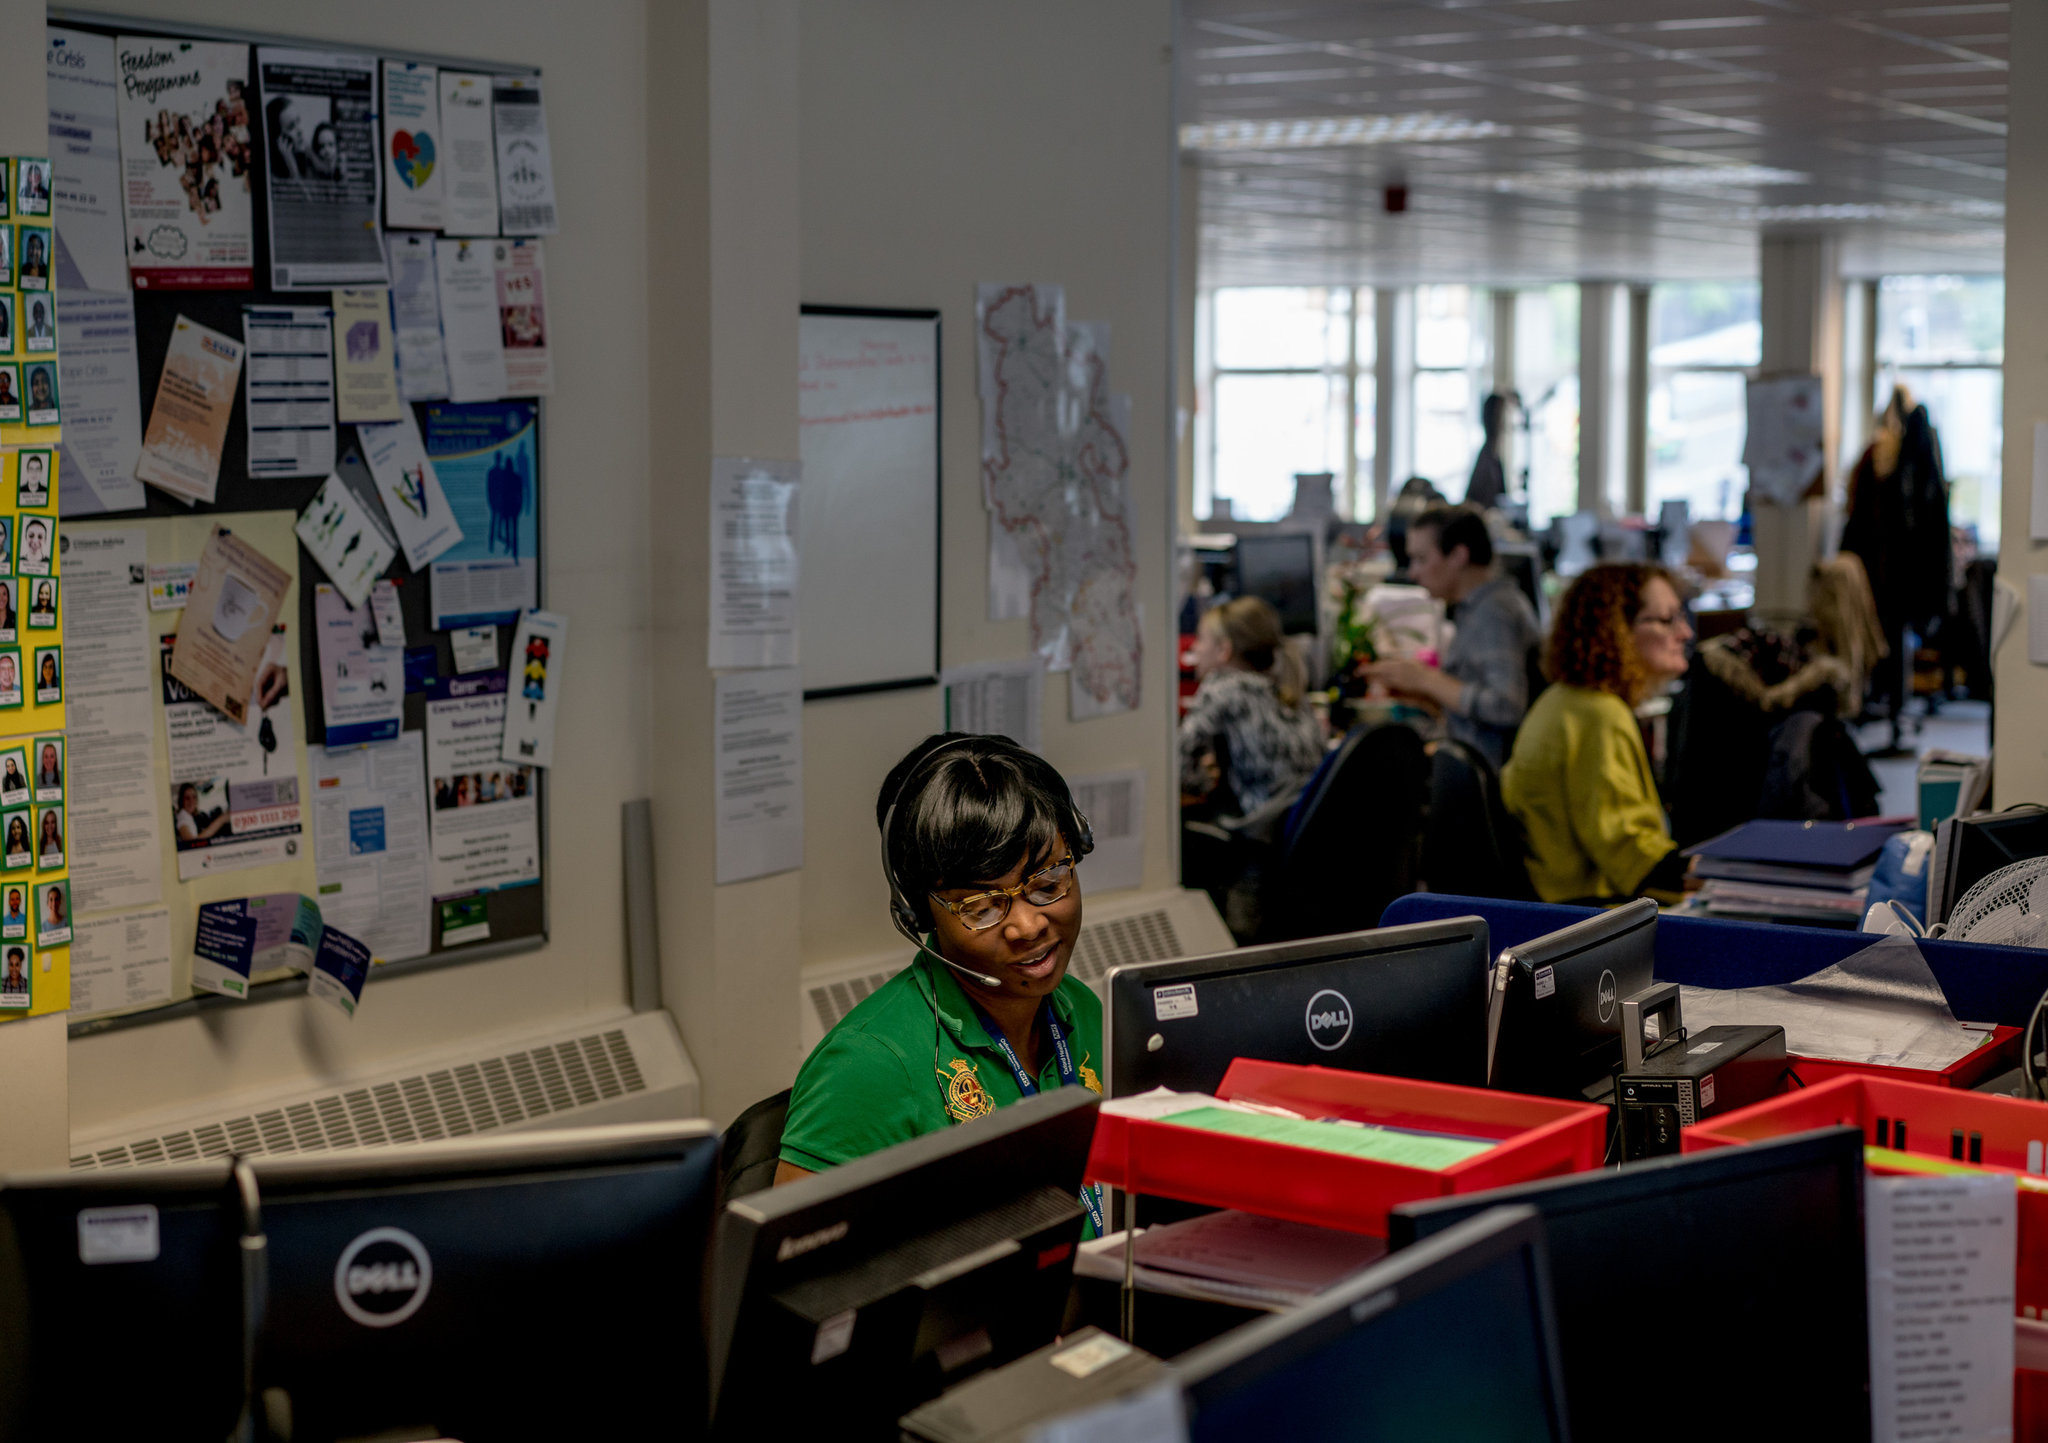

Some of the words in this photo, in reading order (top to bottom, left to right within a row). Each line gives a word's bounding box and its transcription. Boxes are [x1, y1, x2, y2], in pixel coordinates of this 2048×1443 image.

[57, 49, 86, 69] Crisis
[121, 46, 175, 75] Freedom
[169, 709, 188, 718] Could
[1600, 988, 1614, 1005] DELL
[1309, 1009, 1348, 1030] DELL
[1050, 1024, 1060, 1039] NHS
[1056, 1040, 1065, 1057] Health
[1000, 1038, 1012, 1054] Oxford
[1011, 1053, 1020, 1069] Health
[1018, 1070, 1030, 1087] NHS
[1060, 1057, 1069, 1075] Oxford
[1084, 1193, 1094, 1210] Health
[1092, 1210, 1102, 1227] NHS
[350, 1260, 419, 1295] DELL
